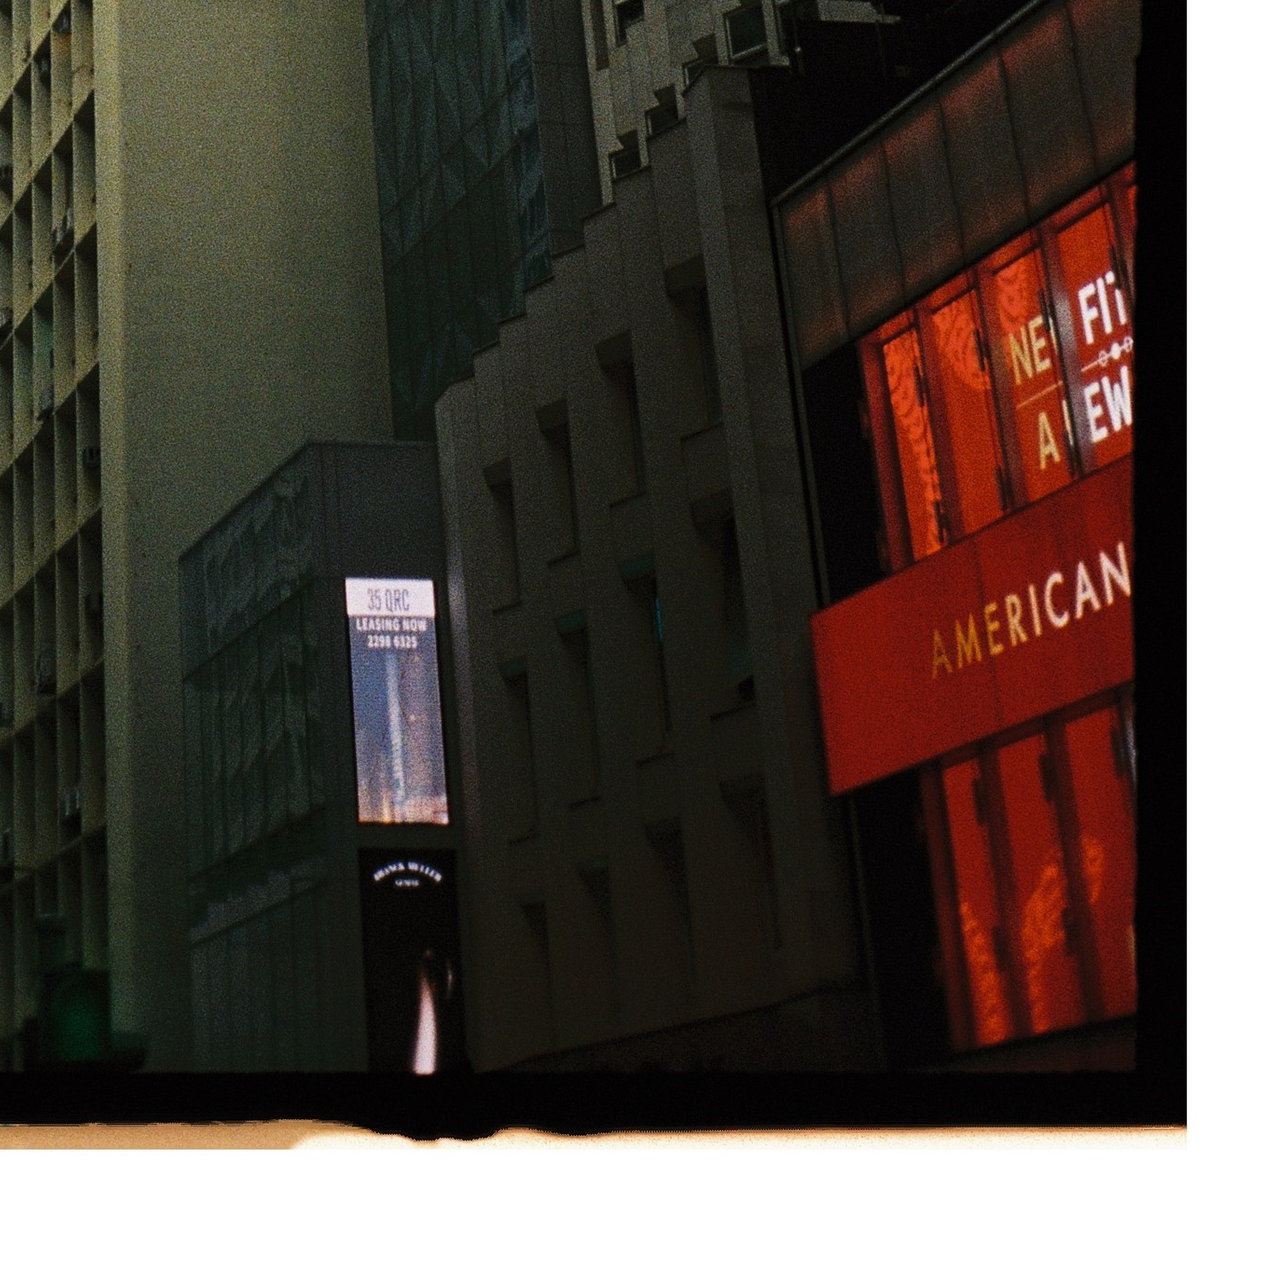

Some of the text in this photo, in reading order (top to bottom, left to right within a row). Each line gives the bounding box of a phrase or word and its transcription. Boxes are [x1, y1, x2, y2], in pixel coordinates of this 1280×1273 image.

[1009, 314, 1058, 385] NE
[356, 617, 428, 632] LEASING NOW
[367, 588, 410, 613] 35 QRC
[931, 542, 1132, 680] AMERICAN
